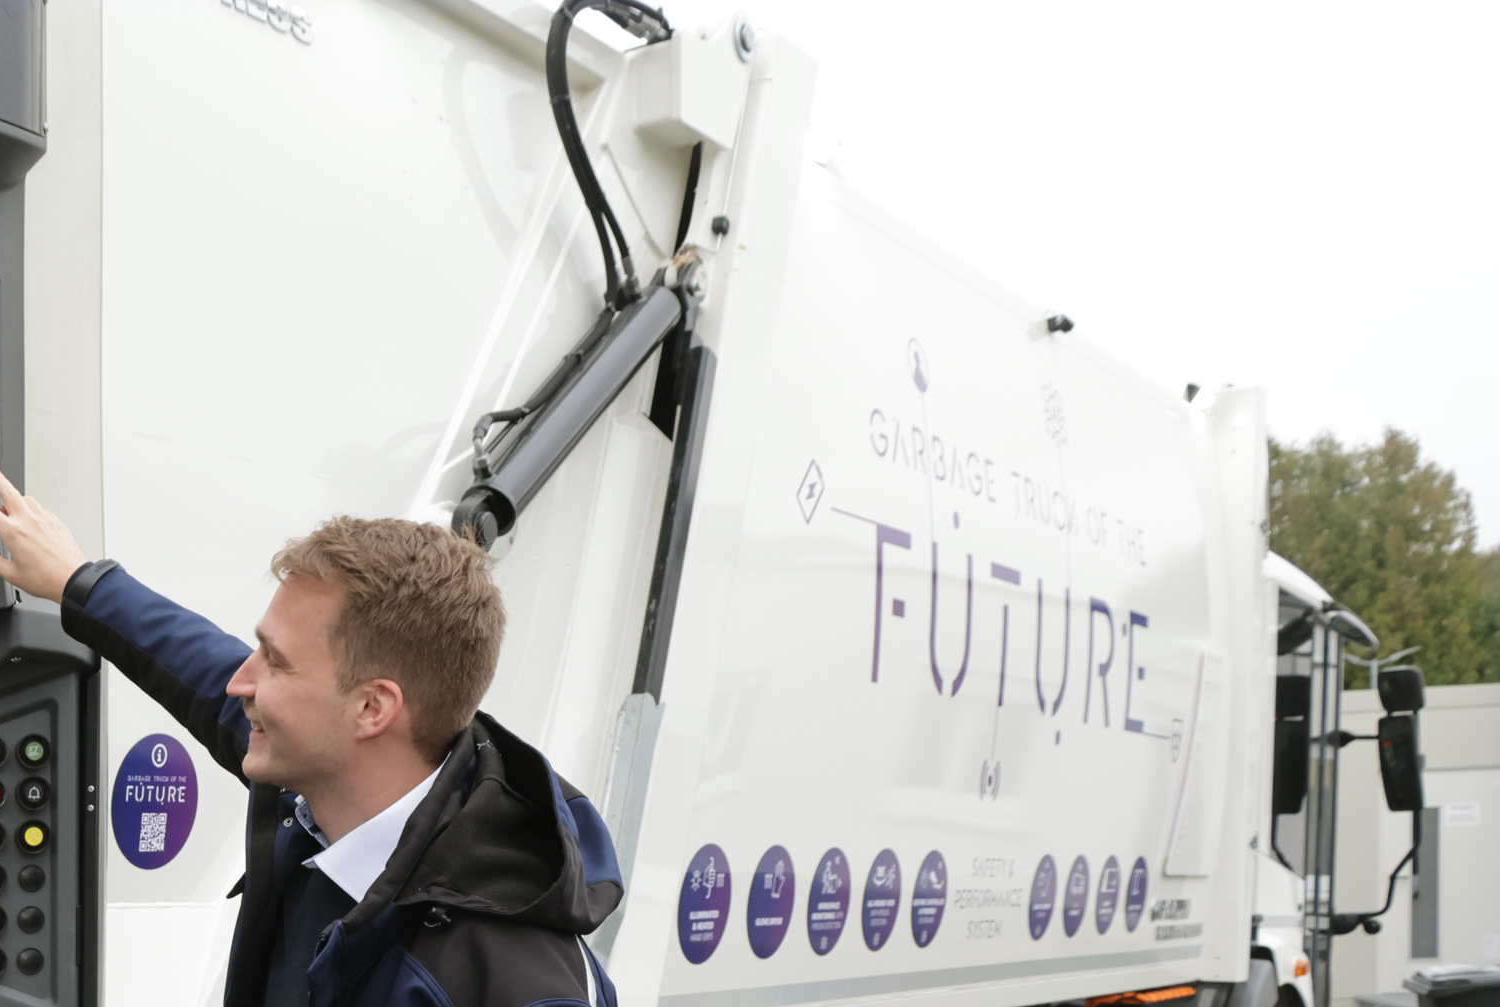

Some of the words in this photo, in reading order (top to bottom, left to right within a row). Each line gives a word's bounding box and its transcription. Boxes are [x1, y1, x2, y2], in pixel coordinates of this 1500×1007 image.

[869, 407, 997, 503] GARBAGE
[1011, 469, 1080, 538] TRUCK
[1087, 506, 1108, 550] OF
[1116, 517, 1148, 567] THE
[871, 520, 1150, 736] FUTURE
[125, 784, 187, 804] FUTURE
